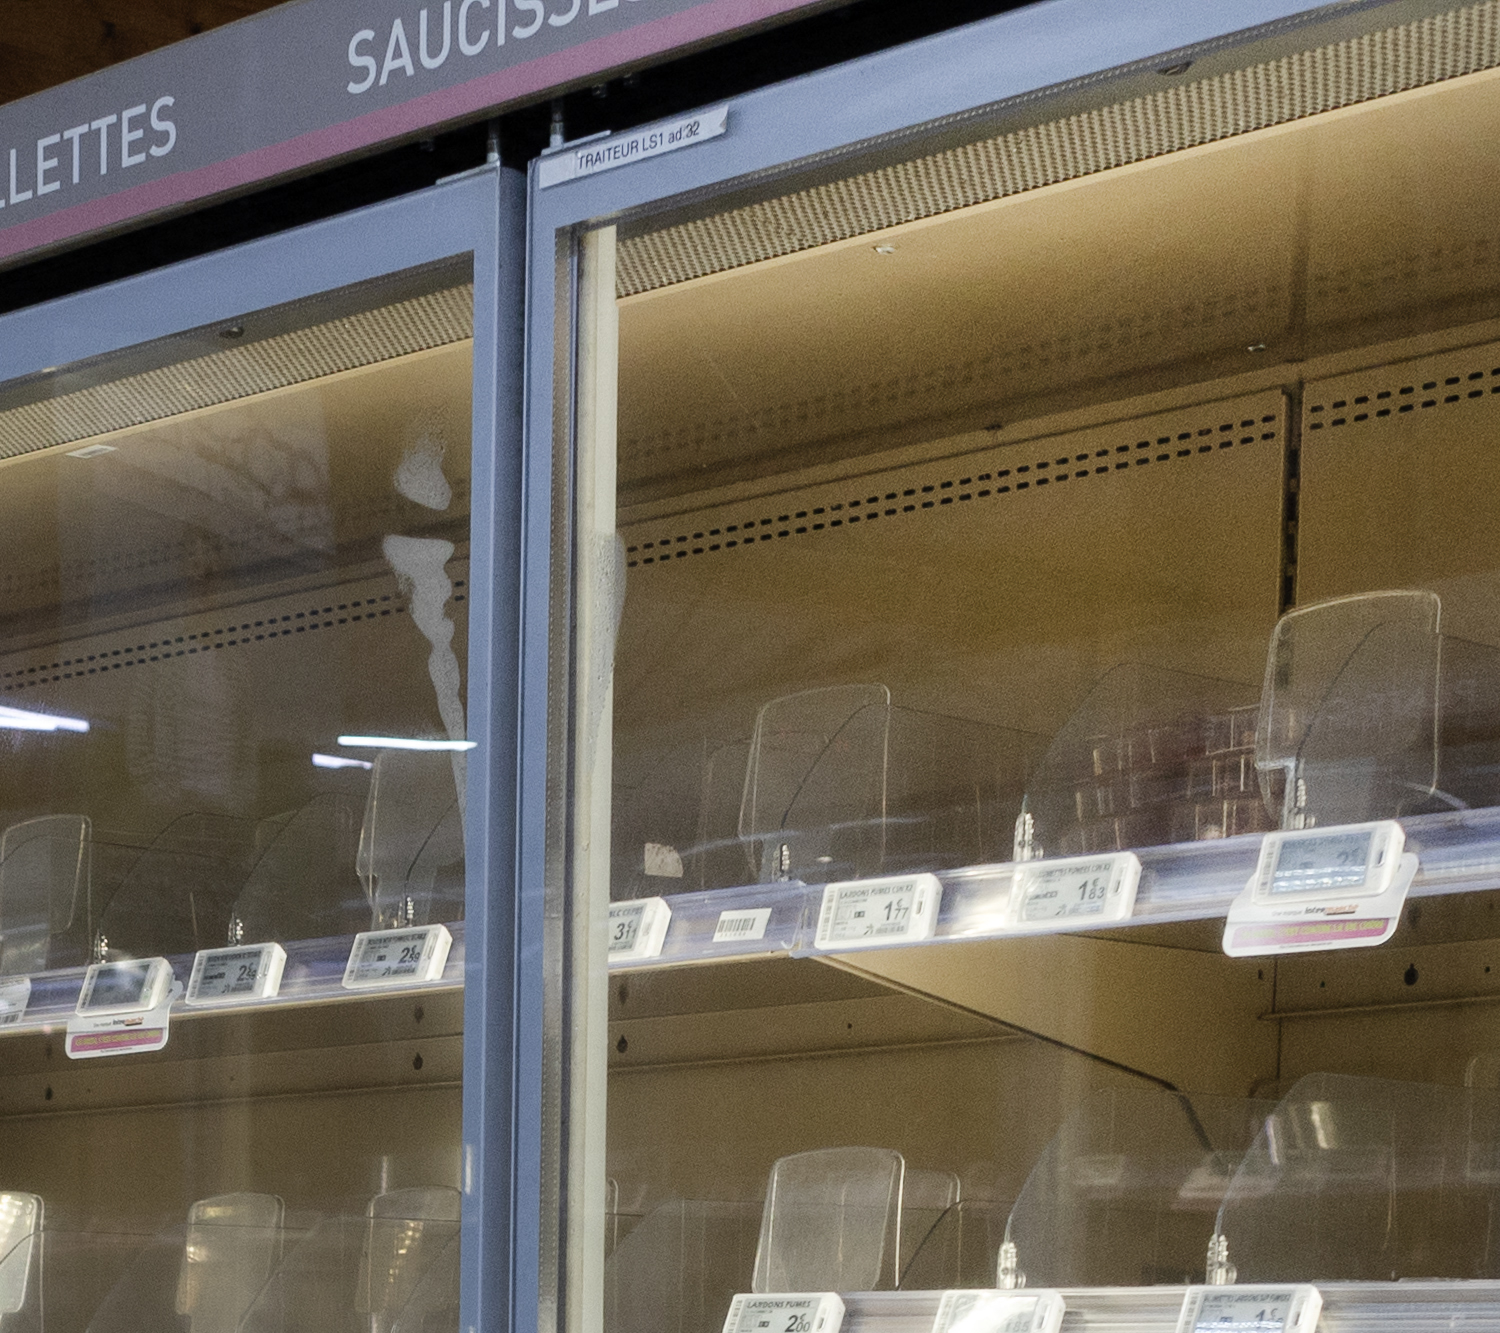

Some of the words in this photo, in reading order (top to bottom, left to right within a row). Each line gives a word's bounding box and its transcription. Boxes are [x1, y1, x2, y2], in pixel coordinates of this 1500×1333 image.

[578, 140, 639, 170] TRAITEUR
[642, 134, 663, 152] LS1
[746, 1300, 783, 1310] LARDONS
